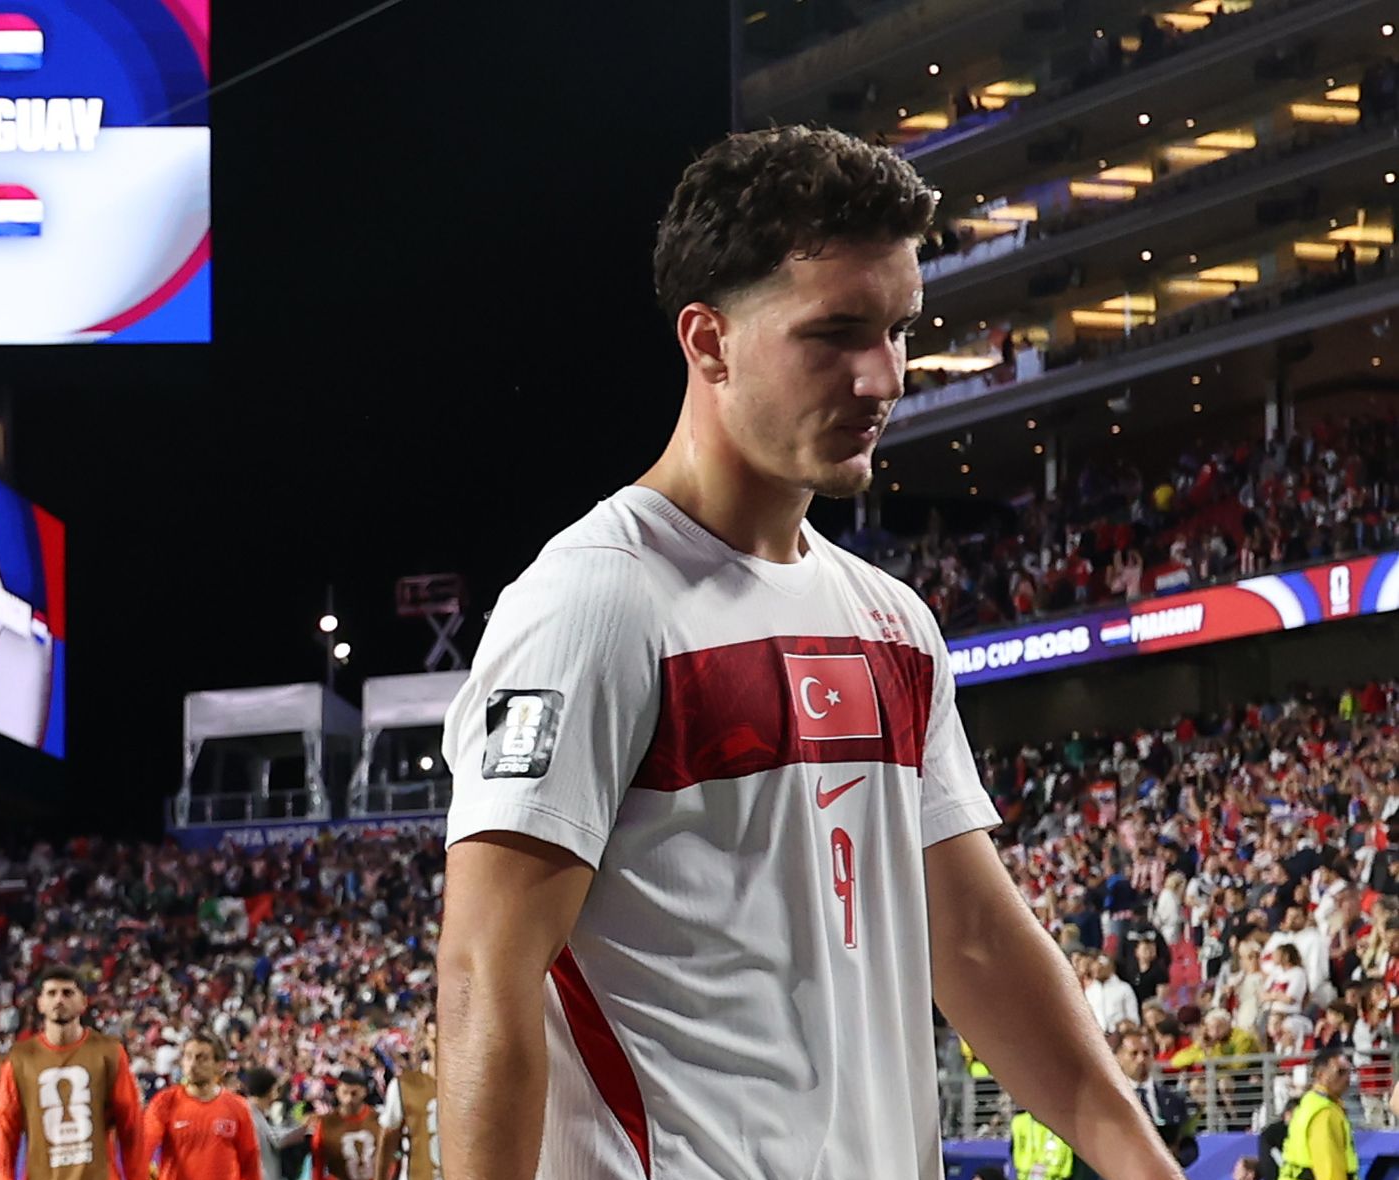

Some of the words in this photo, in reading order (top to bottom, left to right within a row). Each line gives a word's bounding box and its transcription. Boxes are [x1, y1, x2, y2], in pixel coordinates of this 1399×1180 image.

[1130, 603, 1204, 643] PARAGUAY
[987, 639, 1025, 667] CUP
[1023, 627, 1091, 663] 2026
[830, 827, 859, 950] 9
